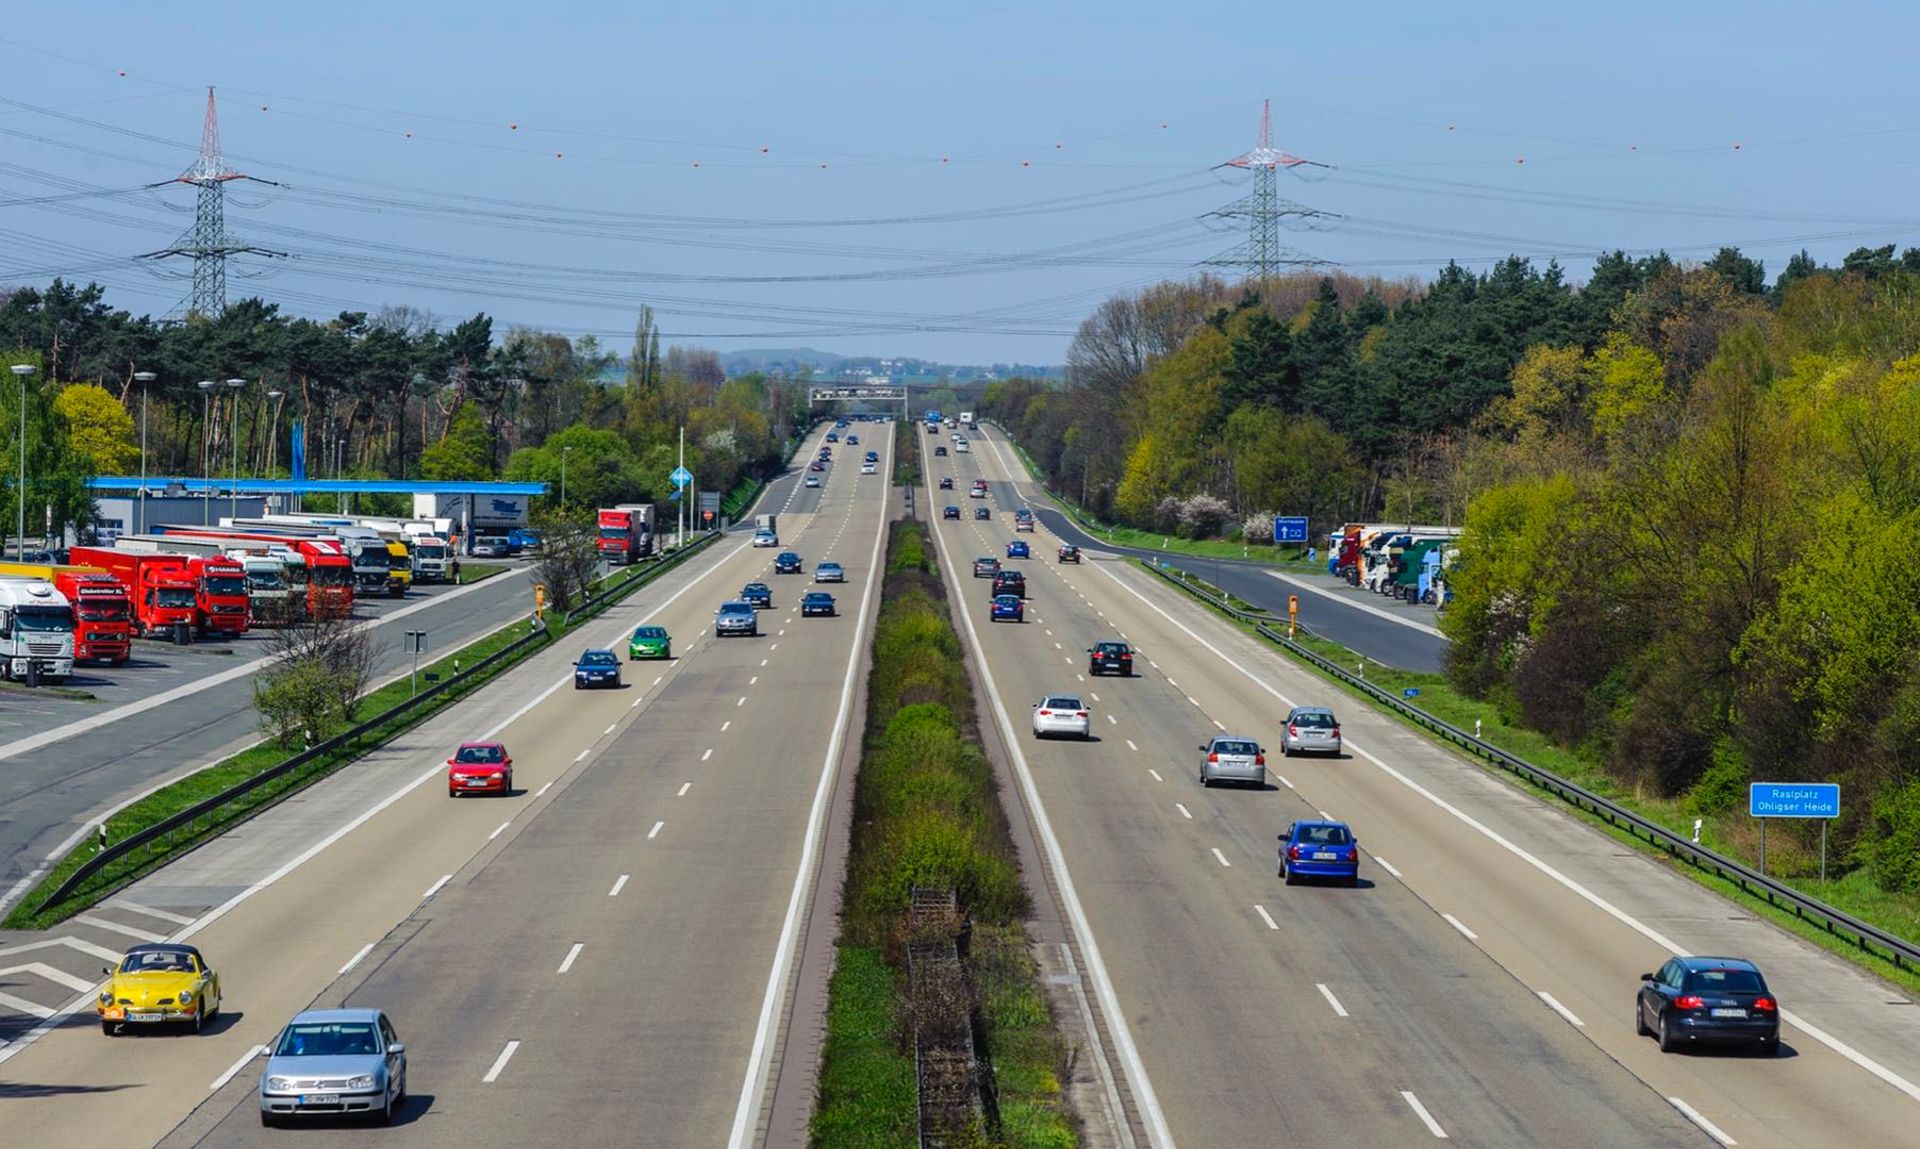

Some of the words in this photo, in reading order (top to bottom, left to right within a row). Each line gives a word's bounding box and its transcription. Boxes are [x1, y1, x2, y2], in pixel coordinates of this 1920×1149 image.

[1772, 789, 1819, 800] Rastplatz
[1758, 801, 1800, 813] Ohligser
[1804, 802, 1833, 812] Heide
